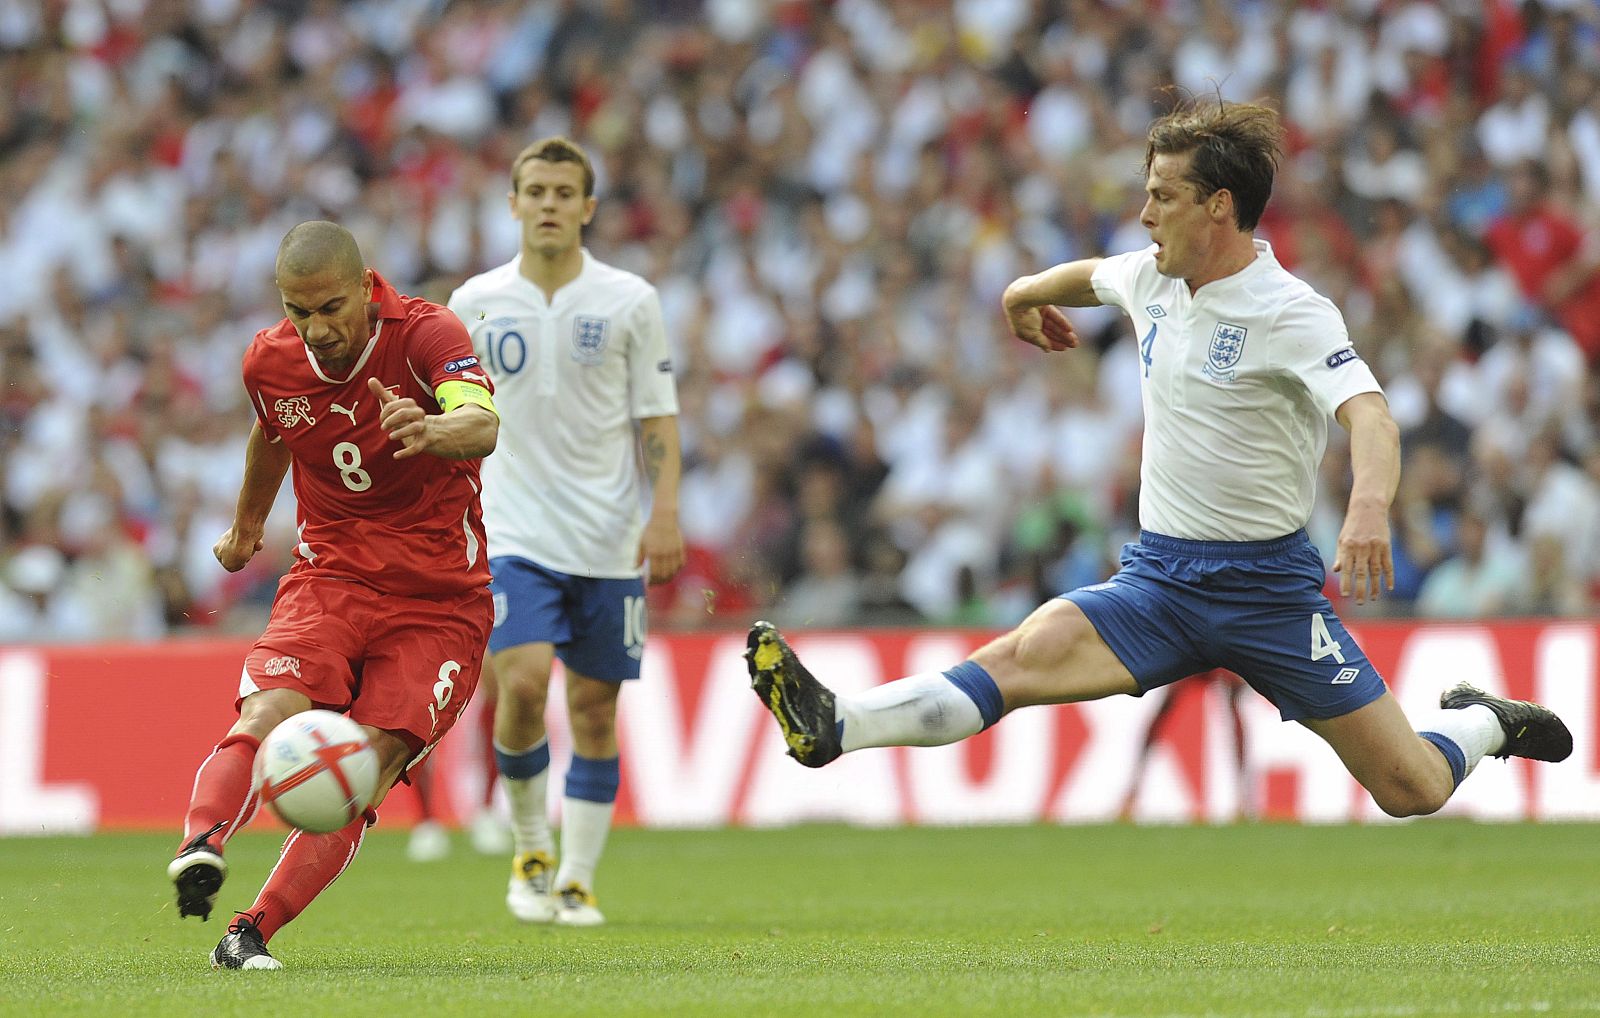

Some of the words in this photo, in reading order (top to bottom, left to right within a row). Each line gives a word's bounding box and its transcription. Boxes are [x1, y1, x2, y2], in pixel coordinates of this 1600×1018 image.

[486, 331, 526, 374] 10
[1141, 322, 1157, 378] 4
[332, 441, 372, 492] 8
[1311, 612, 1345, 664] 4
